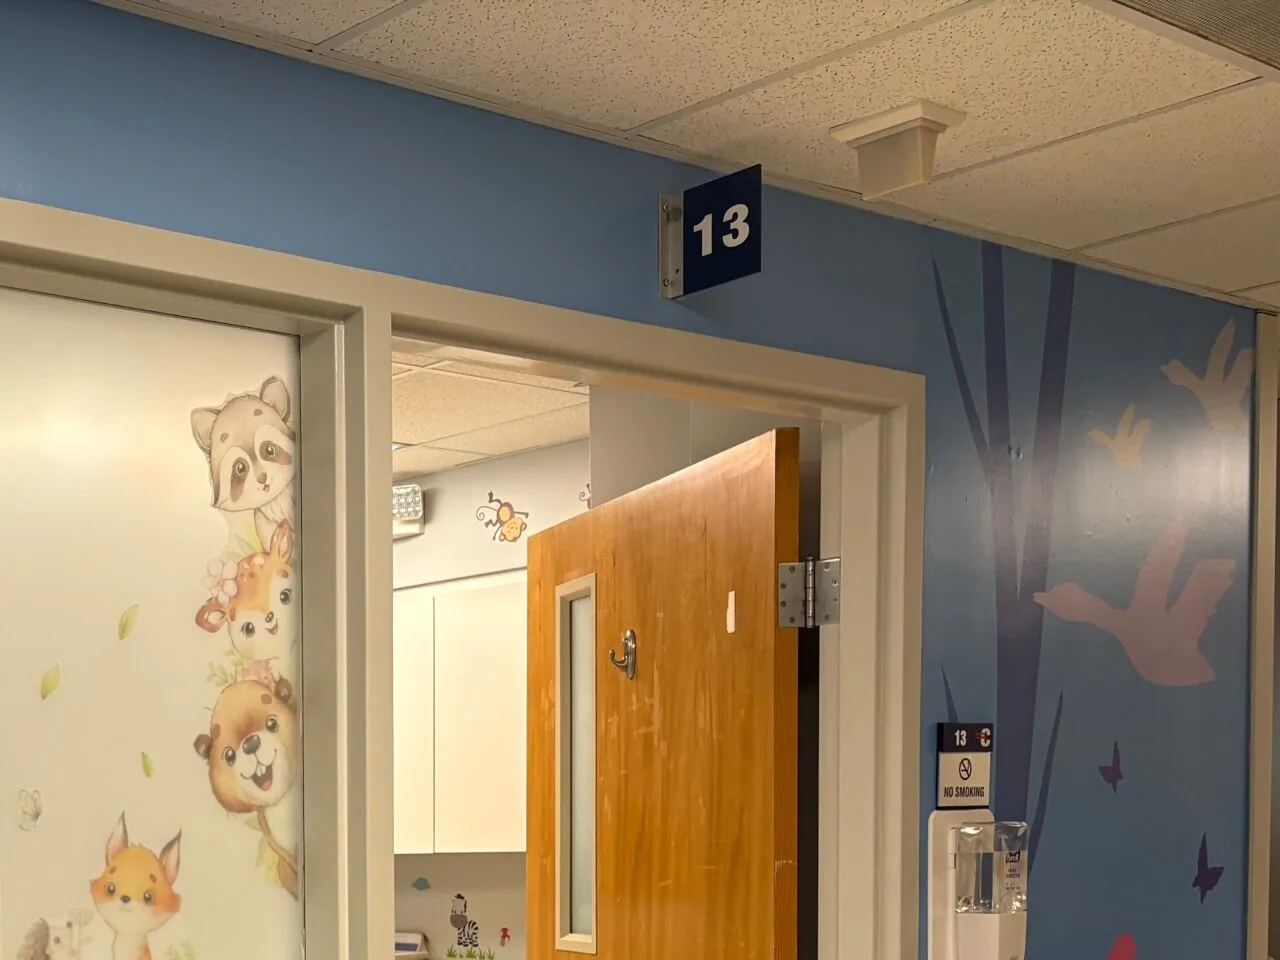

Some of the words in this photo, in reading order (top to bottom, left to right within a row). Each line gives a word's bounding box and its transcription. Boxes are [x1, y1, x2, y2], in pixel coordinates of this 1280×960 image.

[693, 203, 750, 257] 13
[954, 729, 967, 746] 13
[944, 786, 954, 797] NO
[955, 786, 985, 797] SMOKING
